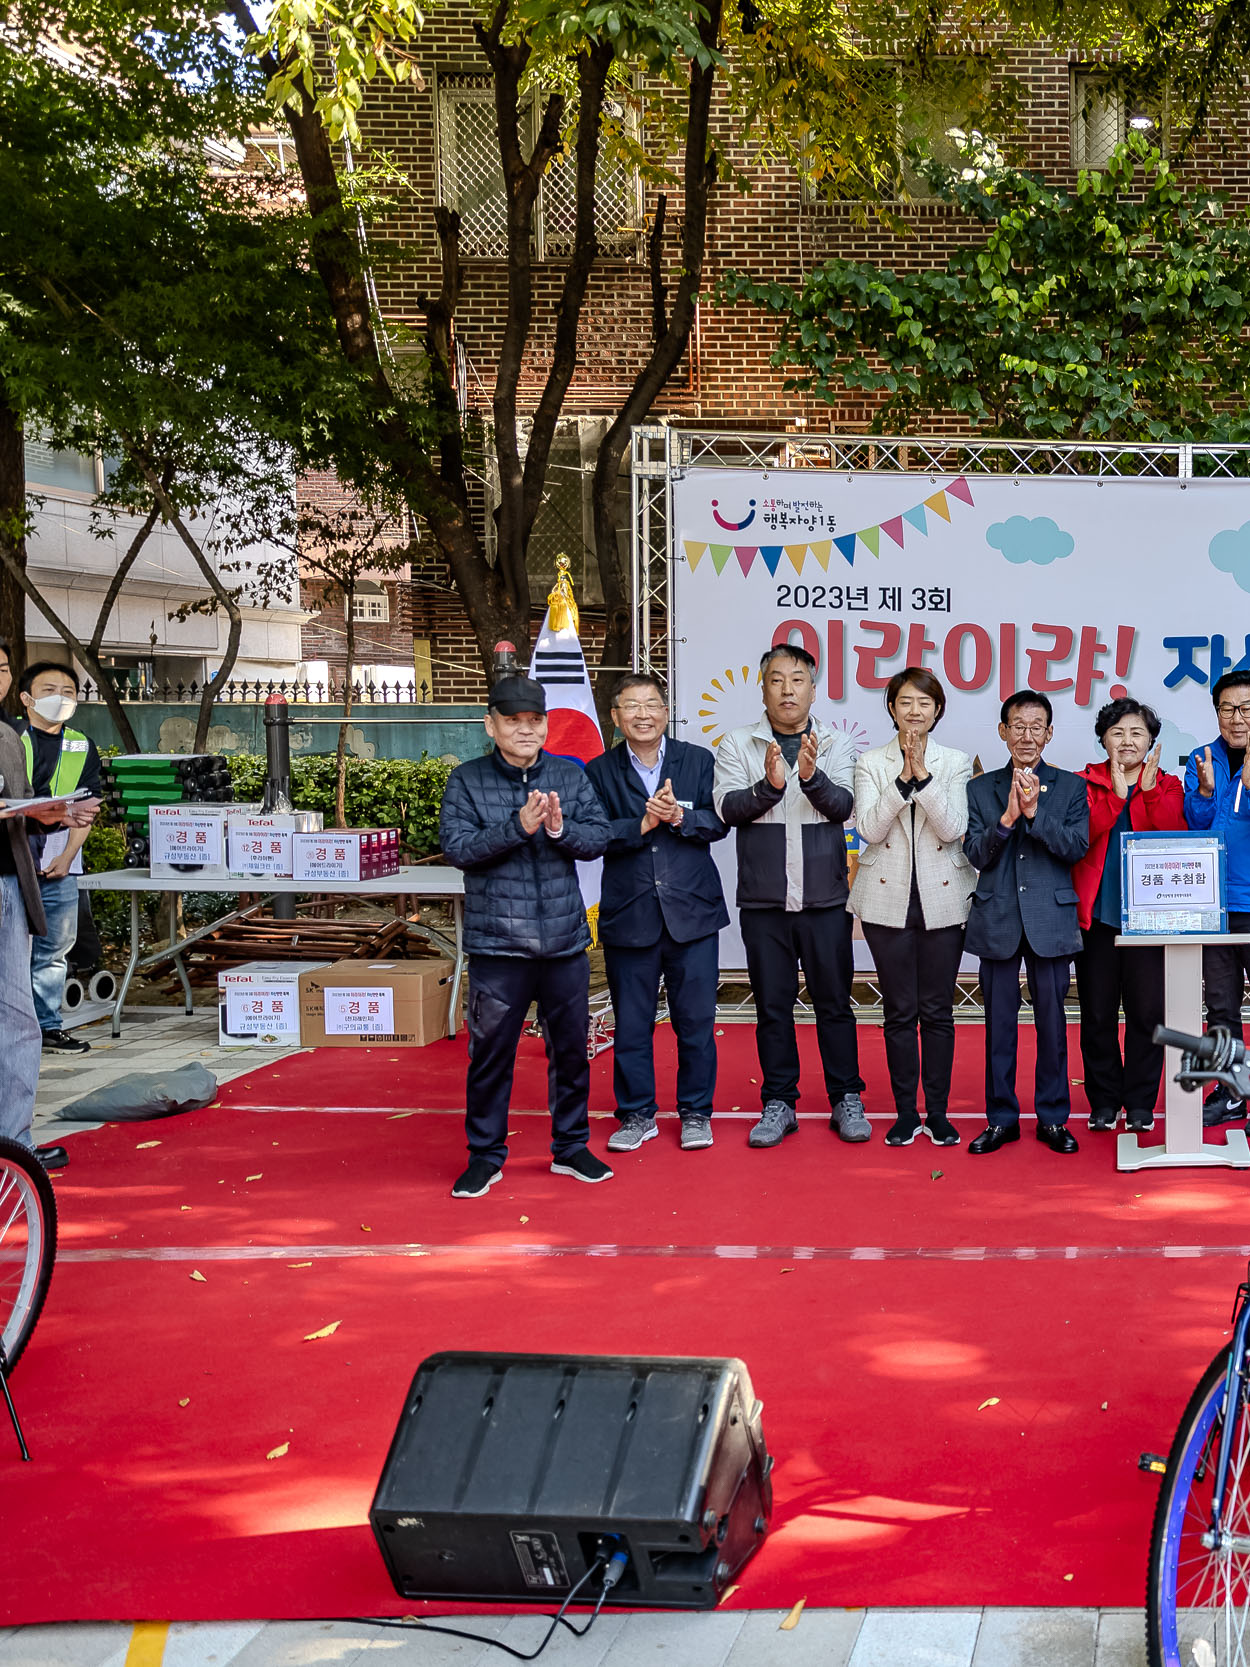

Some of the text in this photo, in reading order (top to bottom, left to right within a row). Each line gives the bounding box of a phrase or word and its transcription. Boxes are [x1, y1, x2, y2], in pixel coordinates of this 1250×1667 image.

[763, 499, 823, 513] 소통하며 발전하는
[763, 512, 837, 533] 행복자양1동
[776, 584, 952, 613] 2023년 제 3회
[771, 619, 1137, 707] 이랴이랴!
[1141, 872, 1206, 886] 경품 추첨함
